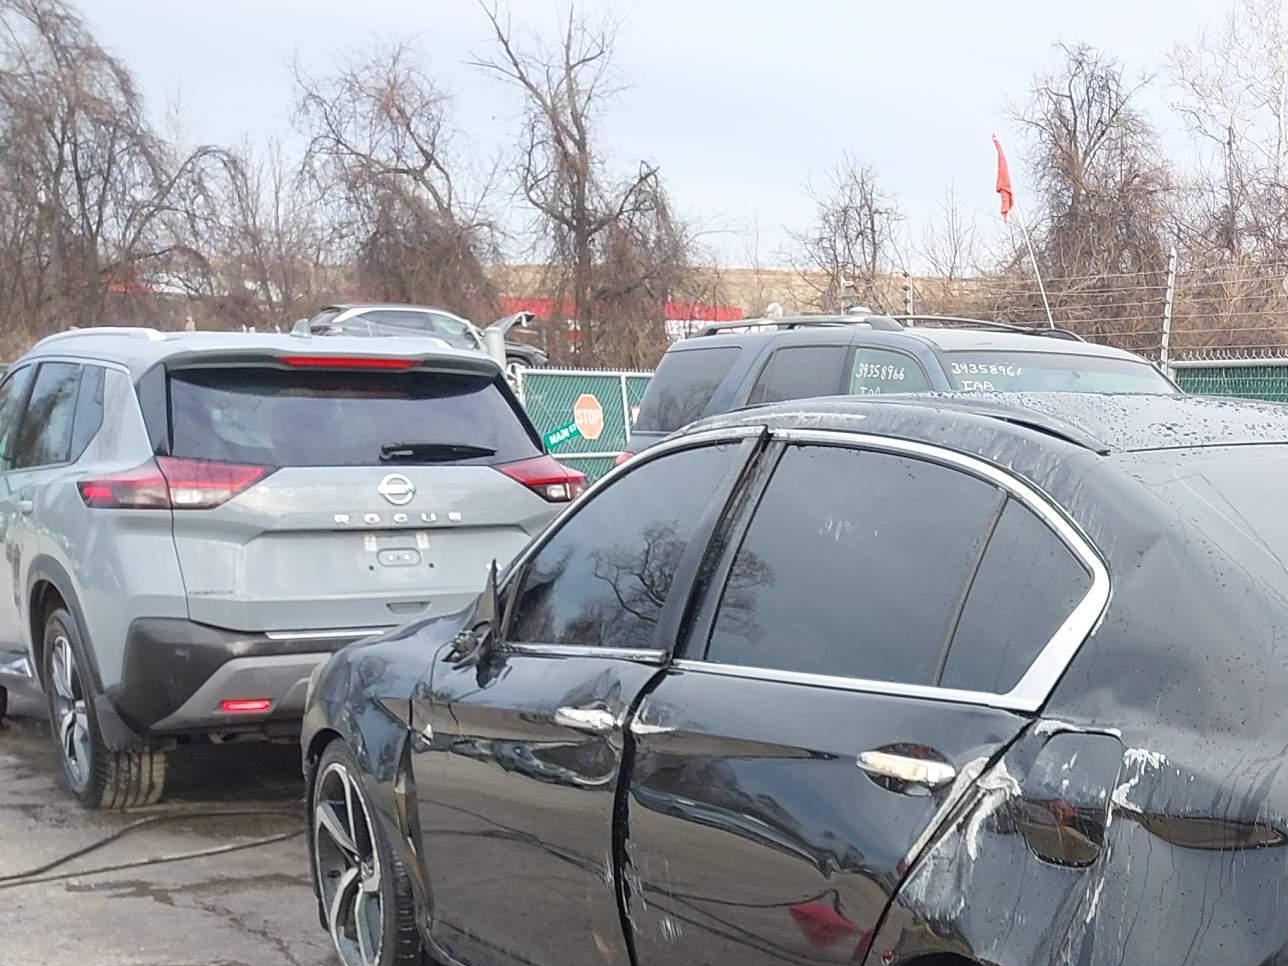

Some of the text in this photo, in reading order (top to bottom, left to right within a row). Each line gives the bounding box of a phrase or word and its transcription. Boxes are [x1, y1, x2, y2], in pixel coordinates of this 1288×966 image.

[575, 408, 602, 425] STOP
[549, 427, 571, 445] MAIN
[334, 511, 462, 525] ROGUE
